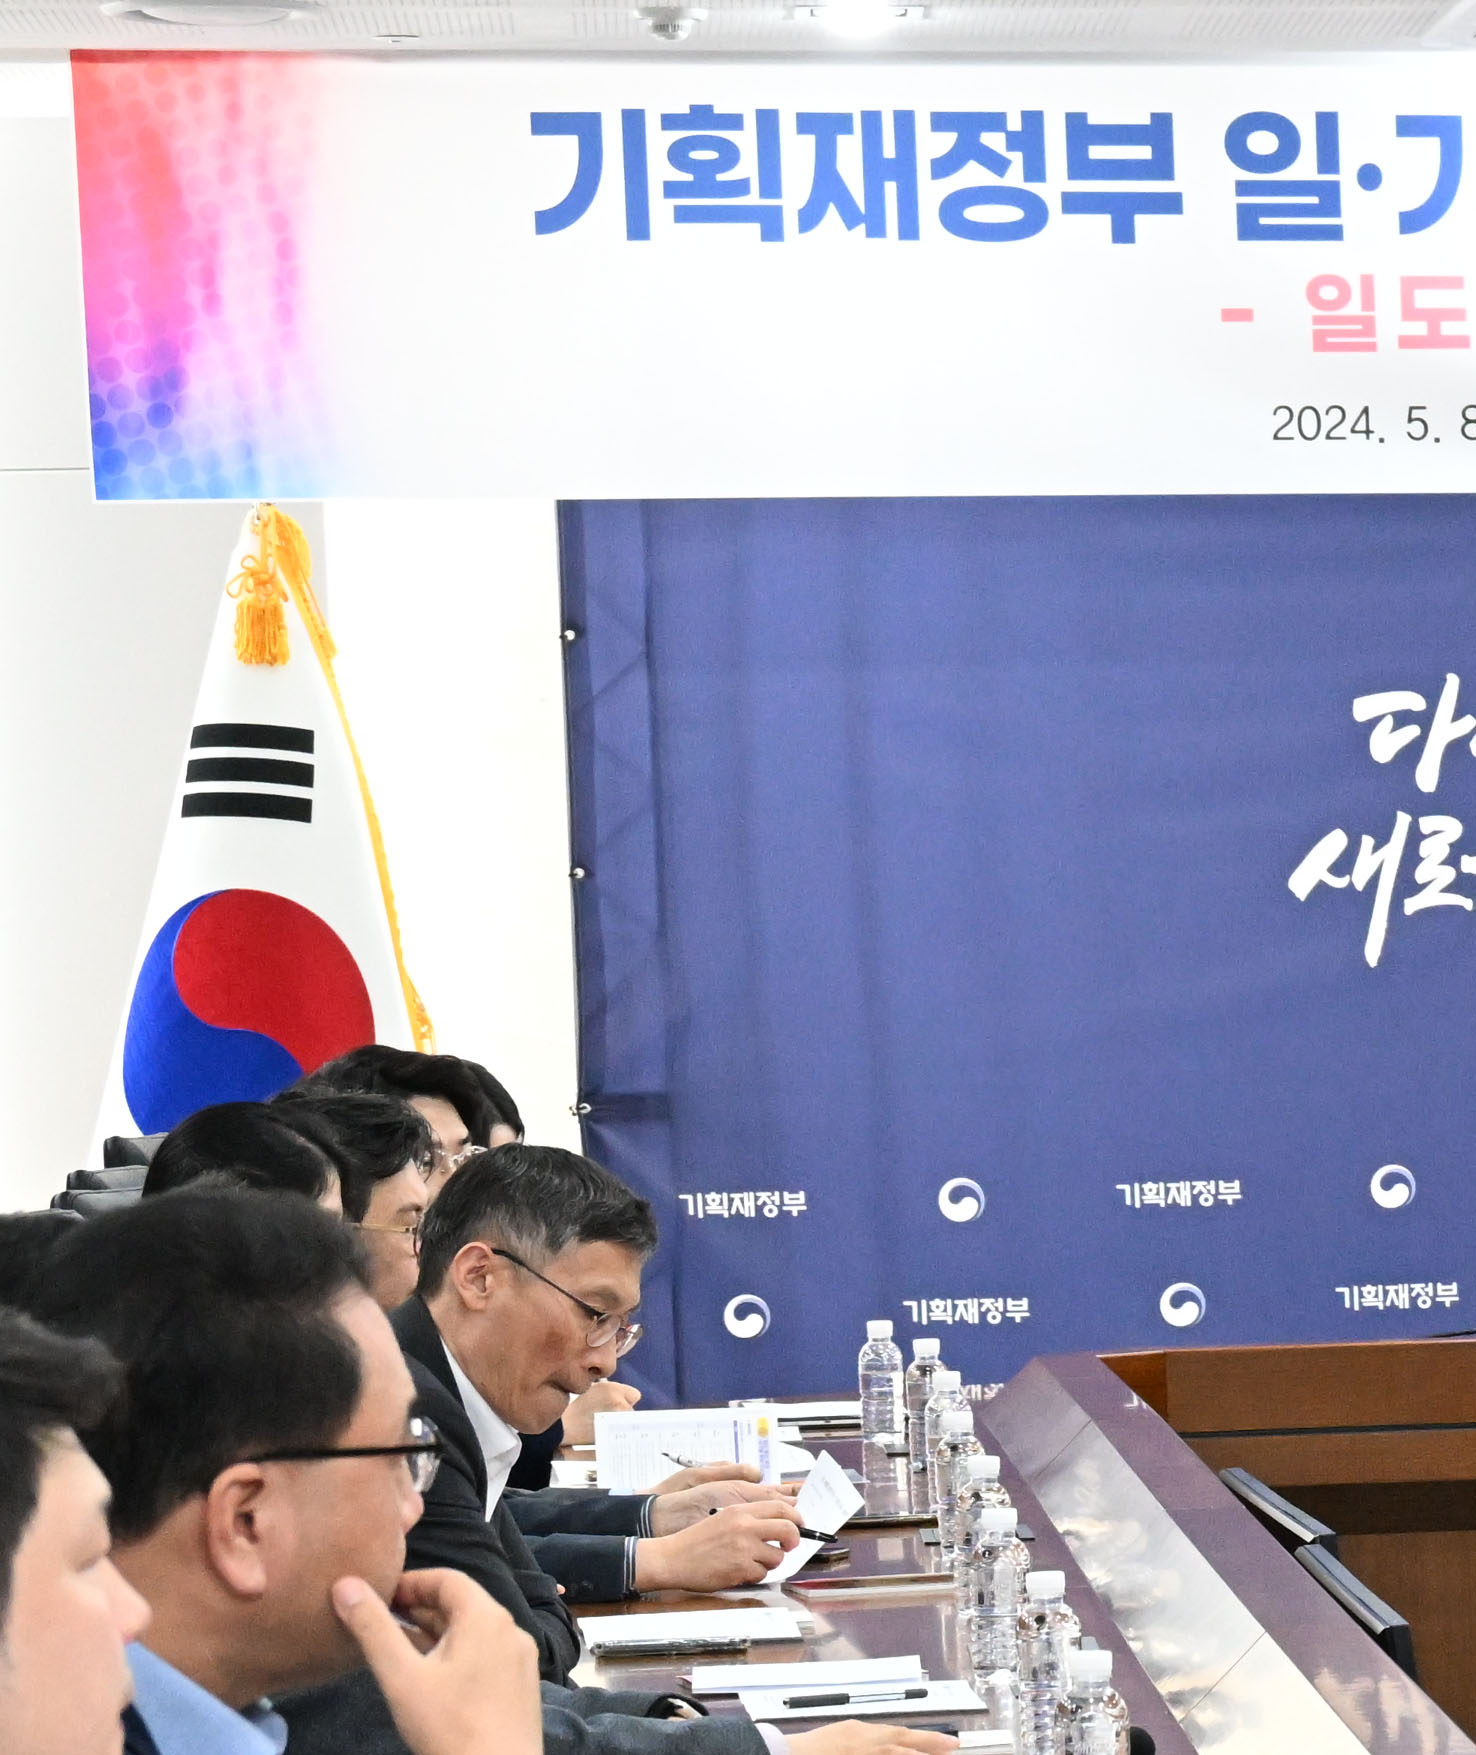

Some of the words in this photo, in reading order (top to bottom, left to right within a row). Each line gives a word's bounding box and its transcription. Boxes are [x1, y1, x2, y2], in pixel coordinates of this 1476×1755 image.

[530, 104, 1184, 245] 기획재정부
[1306, 274, 1471, 353] 일도
[1273, 405, 1385, 444] 2024.
[1406, 405, 1441, 444] 5.
[679, 1191, 807, 1218] 기획재정부
[1116, 1180, 1241, 1208] 기획재정부
[1336, 1282, 1459, 1310] 기획재정부
[901, 1298, 1030, 1326] 기획재정부
